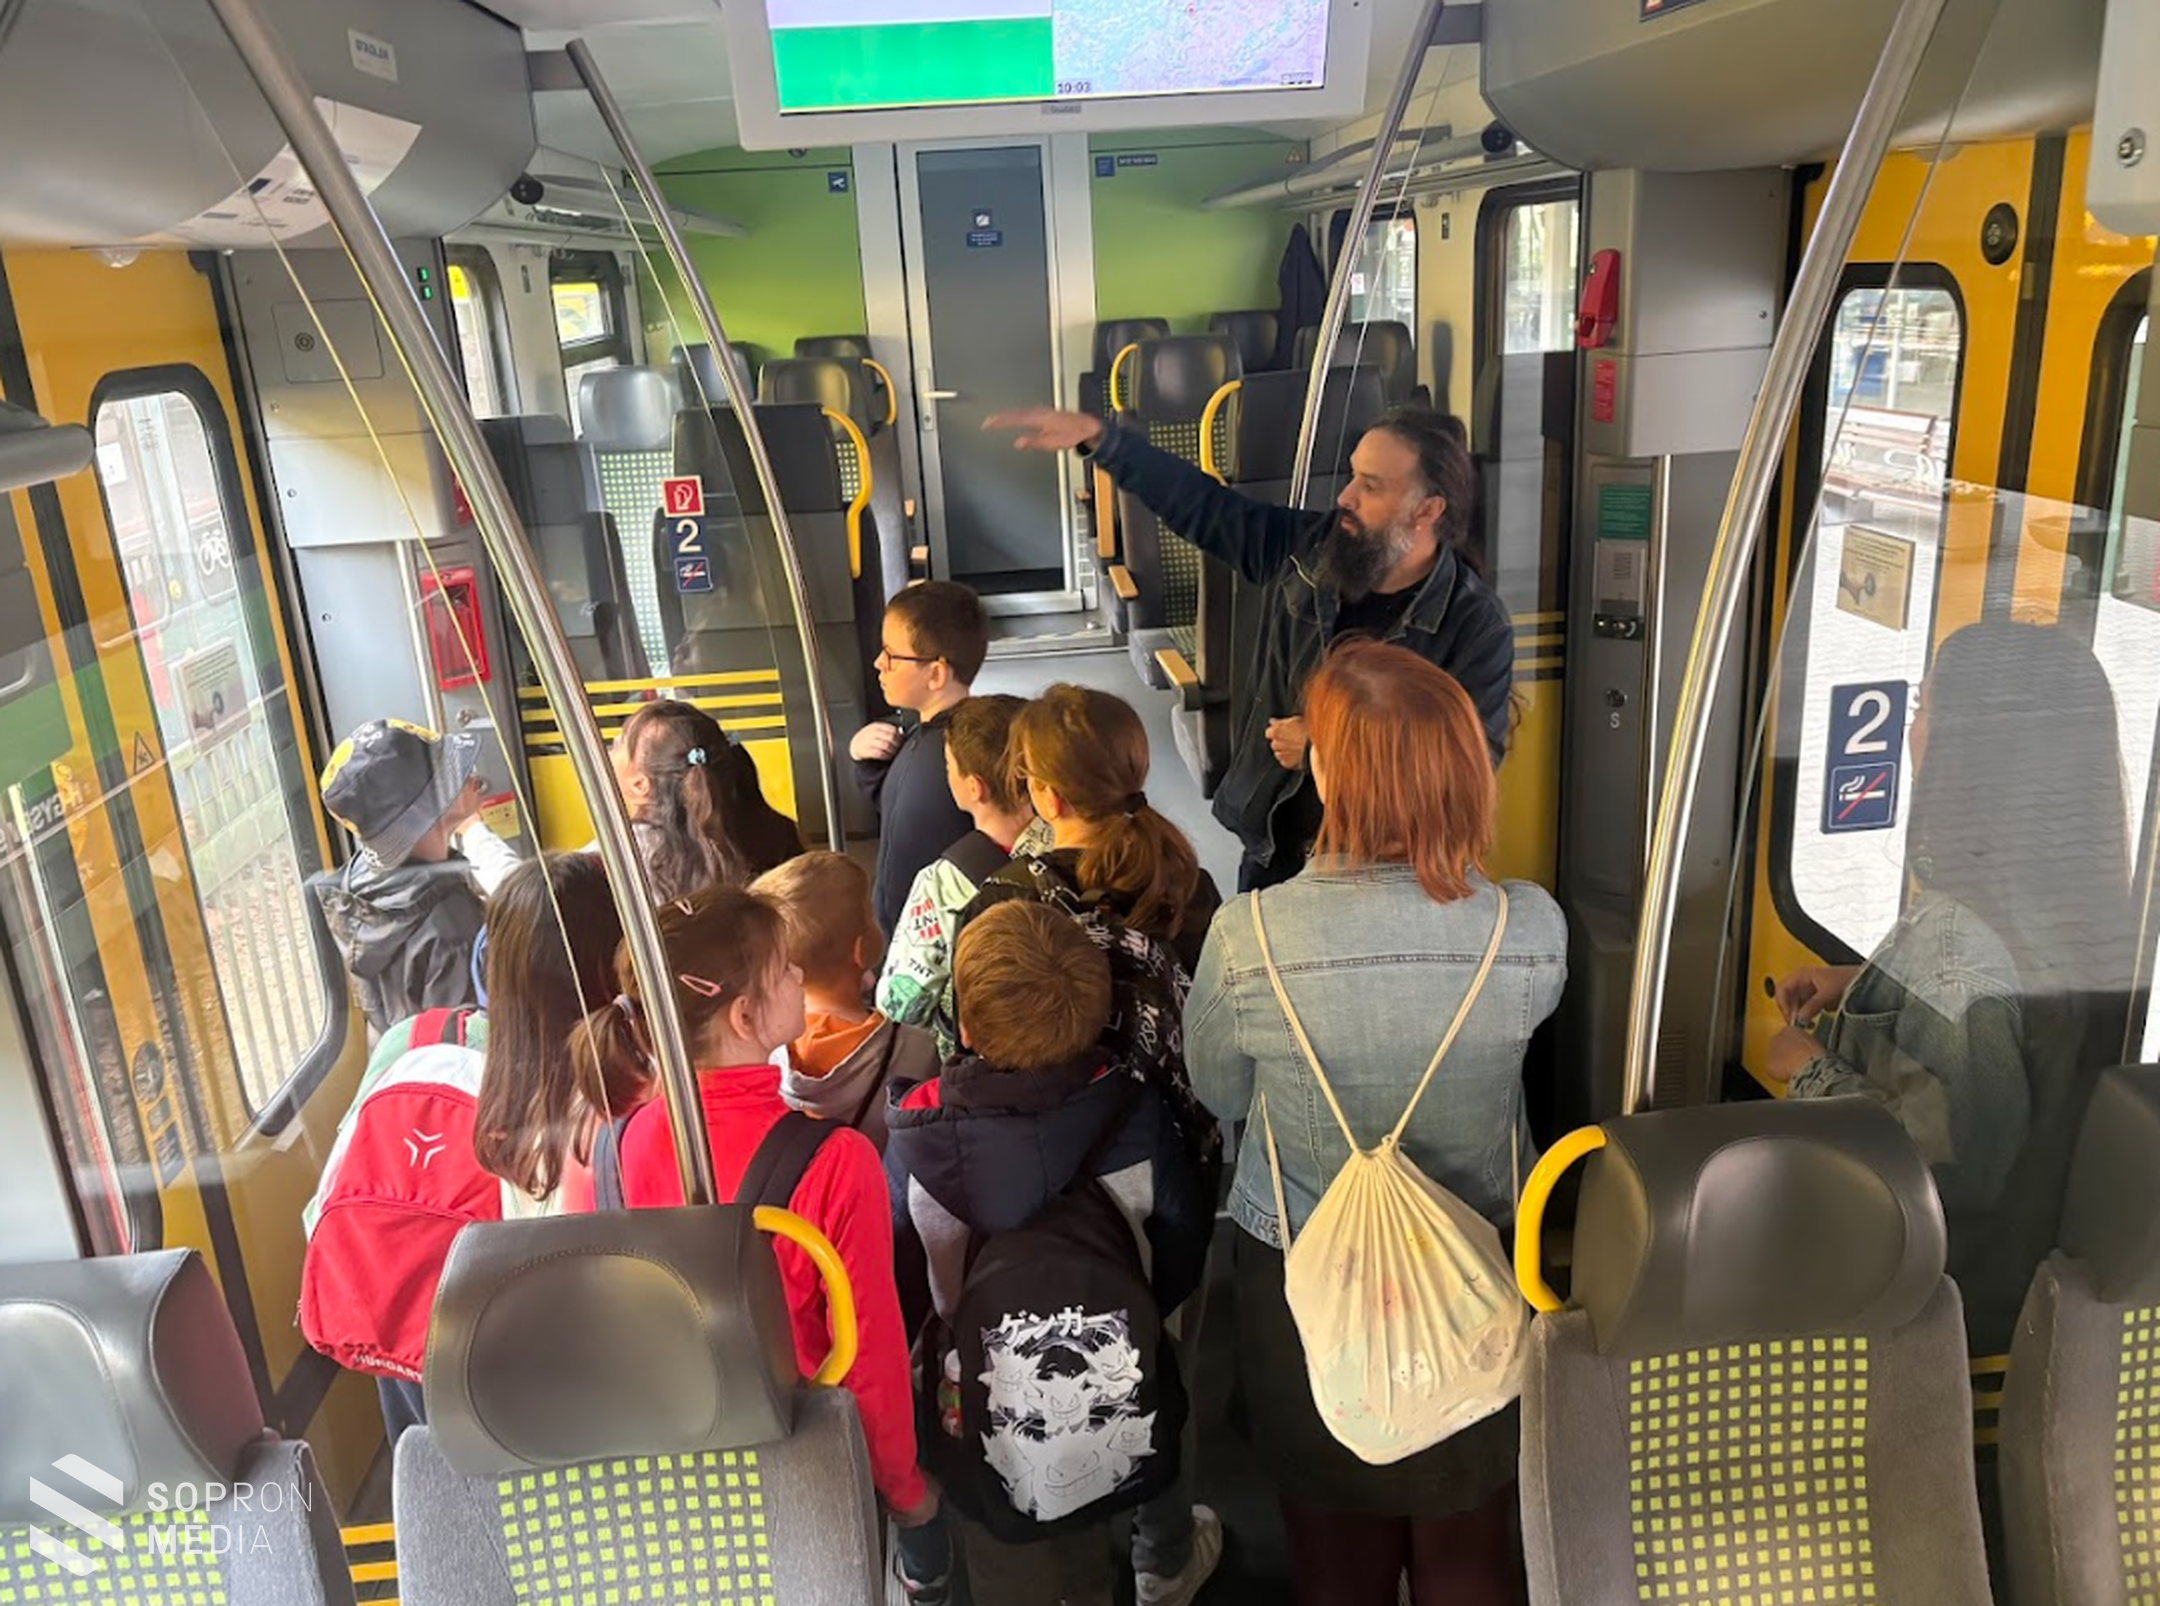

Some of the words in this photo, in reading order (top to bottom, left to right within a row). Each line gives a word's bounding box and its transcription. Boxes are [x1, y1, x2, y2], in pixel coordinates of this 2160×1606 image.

[1057, 81, 1091, 94] 10:03
[676, 518, 702, 553] 2
[1610, 711, 1621, 729] S
[1844, 689, 1891, 755] 2
[908, 957, 936, 978] TNT
[999, 1305, 1113, 1345] ゲンガー
